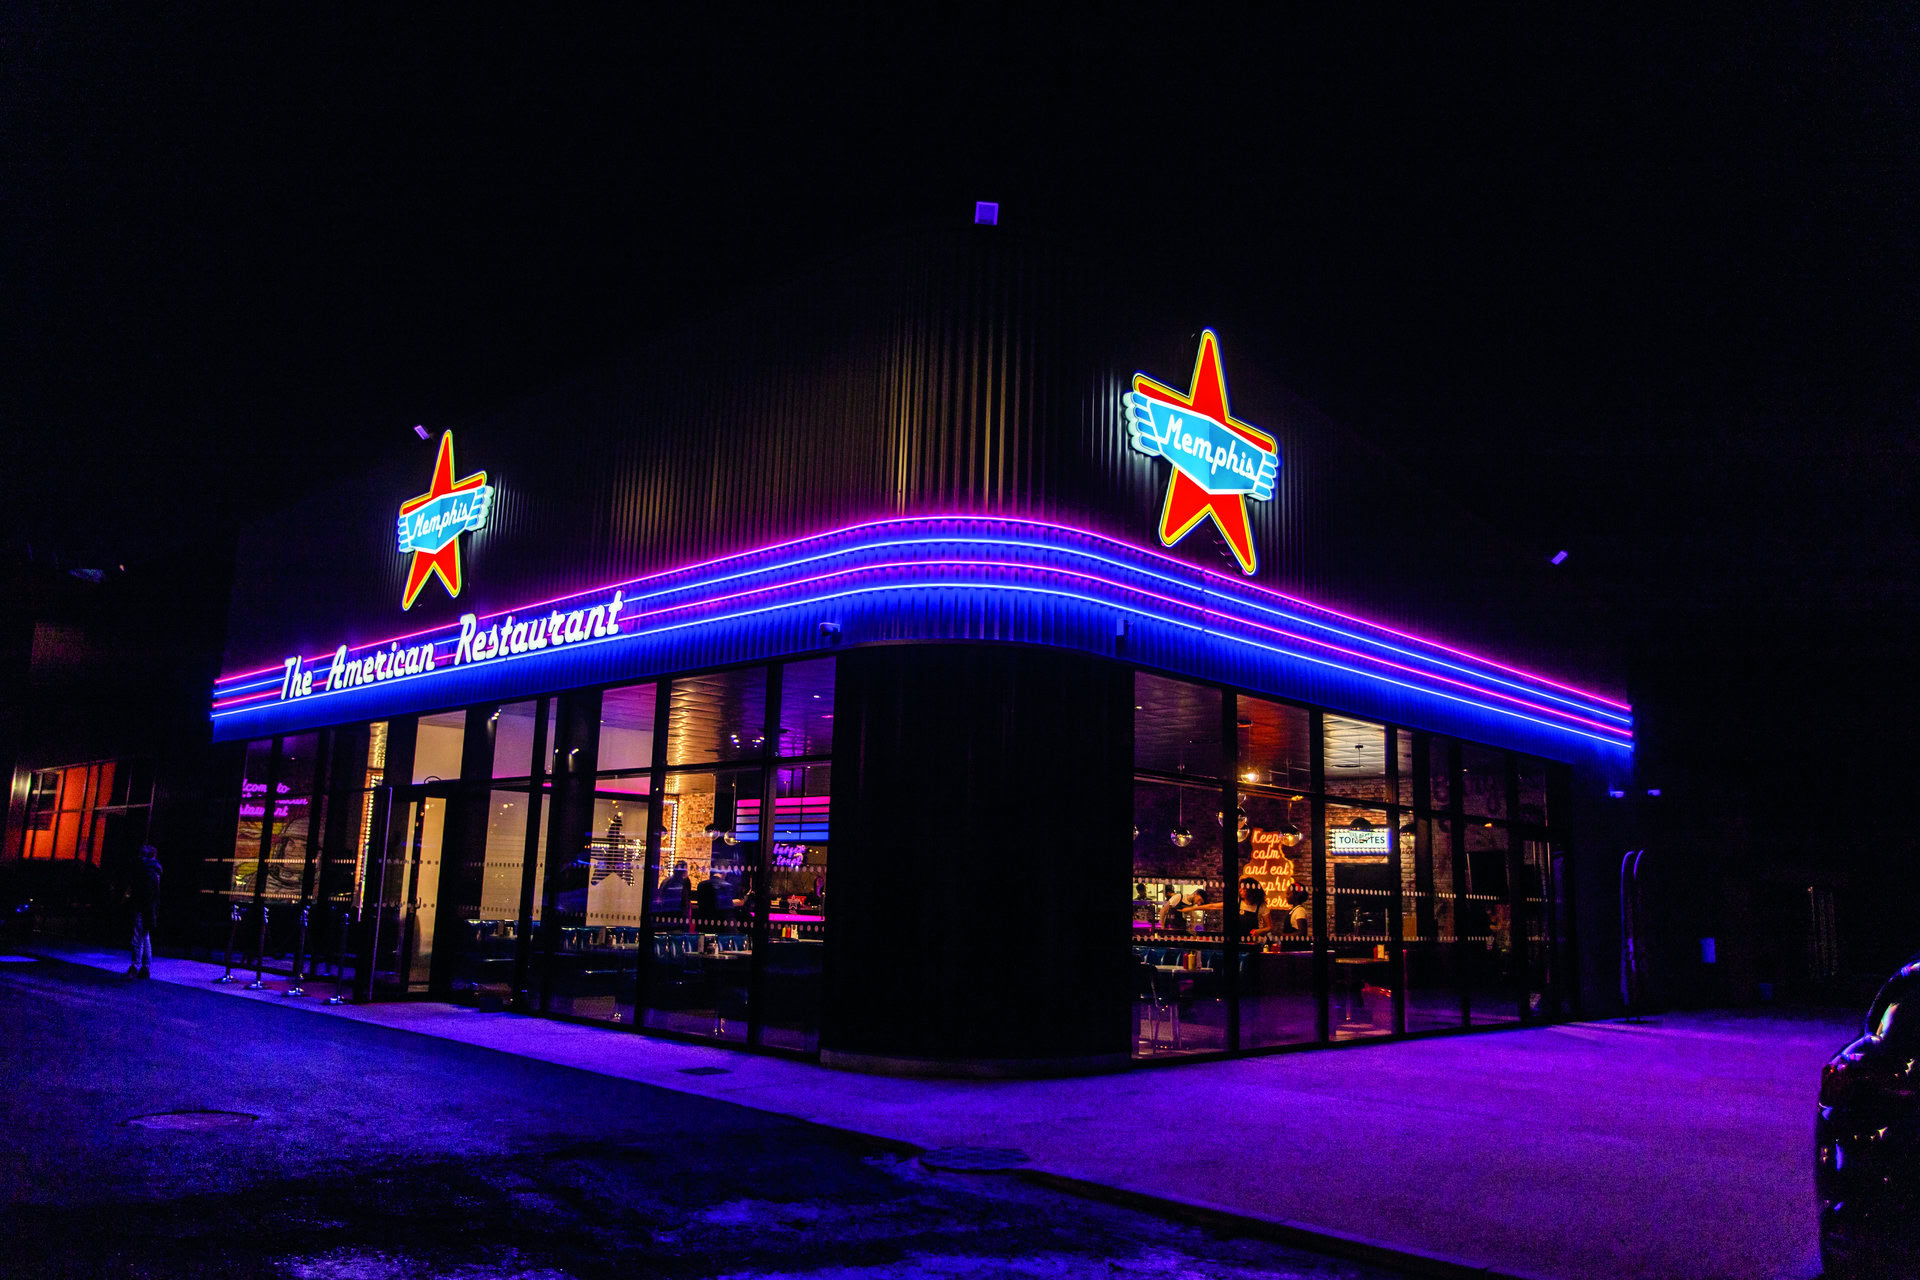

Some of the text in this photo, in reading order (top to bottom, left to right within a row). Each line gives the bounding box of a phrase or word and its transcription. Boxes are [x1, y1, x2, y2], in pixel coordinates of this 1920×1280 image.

[1159, 414, 1256, 480] Memphis
[411, 499, 468, 538] Memphis
[281, 590, 623, 700] The American Restaurant
[1252, 830, 1281, 847] Keep
[1339, 836, 1385, 844] TOITES
[1252, 844, 1281, 859] calm
[1244, 860, 1289, 875] and eat
